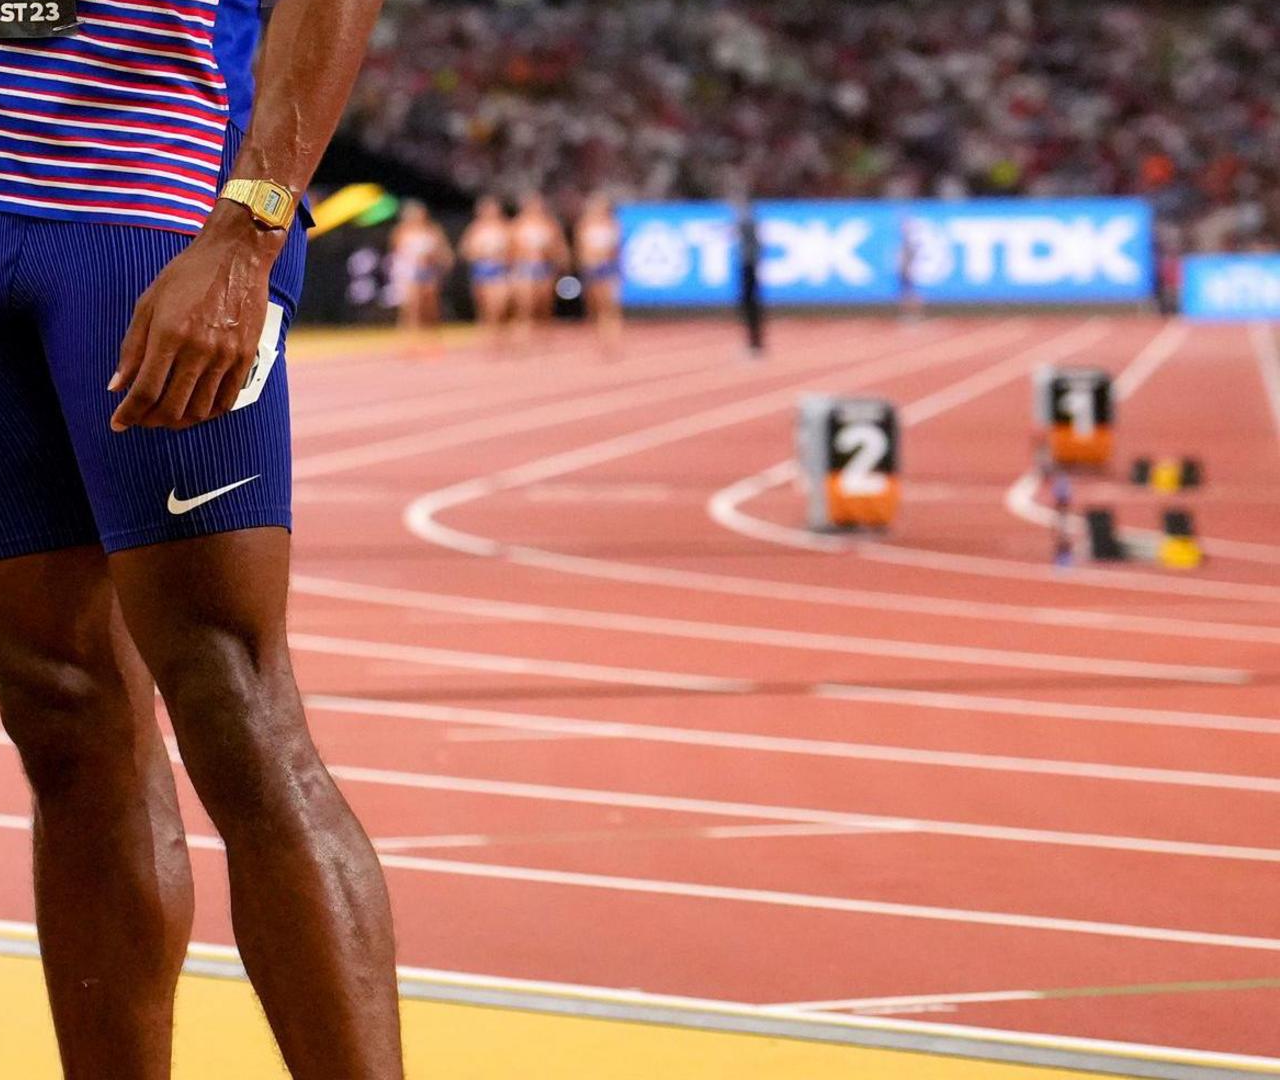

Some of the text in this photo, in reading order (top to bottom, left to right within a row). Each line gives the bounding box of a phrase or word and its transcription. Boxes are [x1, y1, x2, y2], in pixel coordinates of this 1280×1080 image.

[946, 214, 1141, 287] TDK
[1058, 387, 1096, 438] 1
[834, 423, 890, 498] 2
